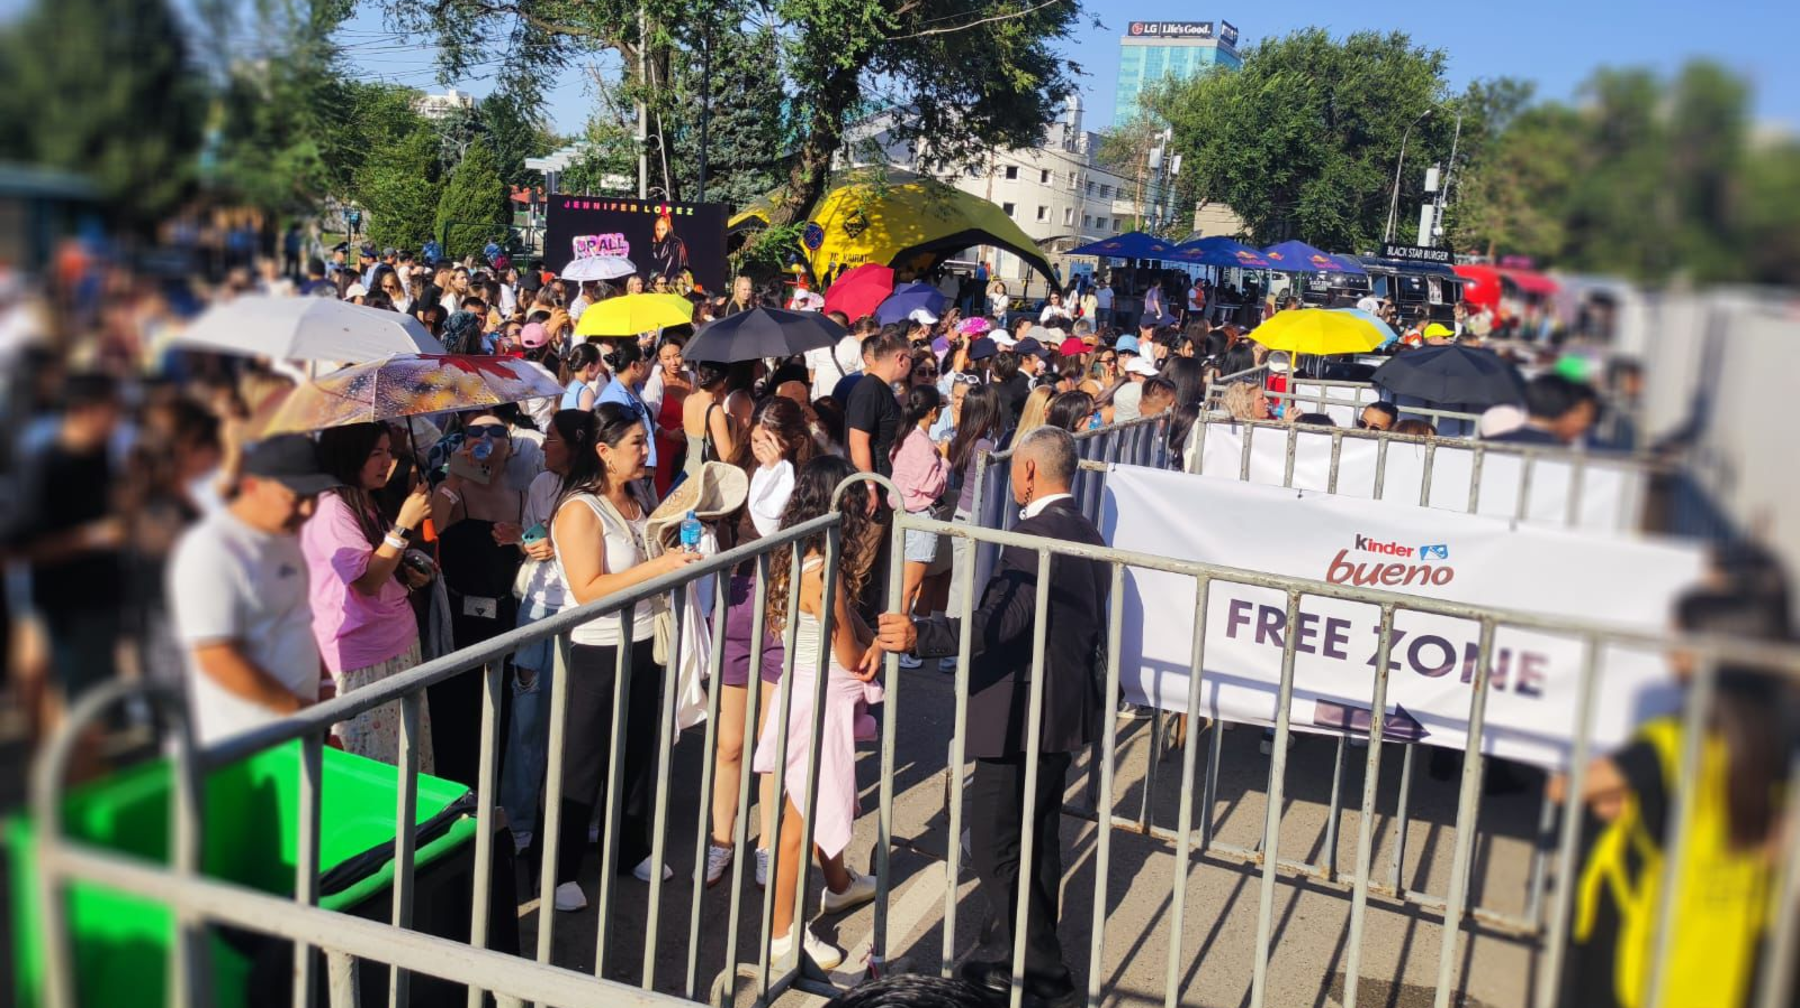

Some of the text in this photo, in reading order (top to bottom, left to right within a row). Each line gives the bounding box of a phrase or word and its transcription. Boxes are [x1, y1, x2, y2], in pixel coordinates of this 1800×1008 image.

[1144, 24, 1157, 33] LG
[1162, 24, 1183, 33] Life's
[564, 200, 693, 215] JENNIFER LOPEZ
[598, 237, 626, 251] ALL
[1386, 245, 1449, 261] BLACK STAR BURGER
[1355, 533, 1414, 557] kinder
[1326, 548, 1454, 586] bueno
[1226, 598, 1549, 698] FREE ZONE
